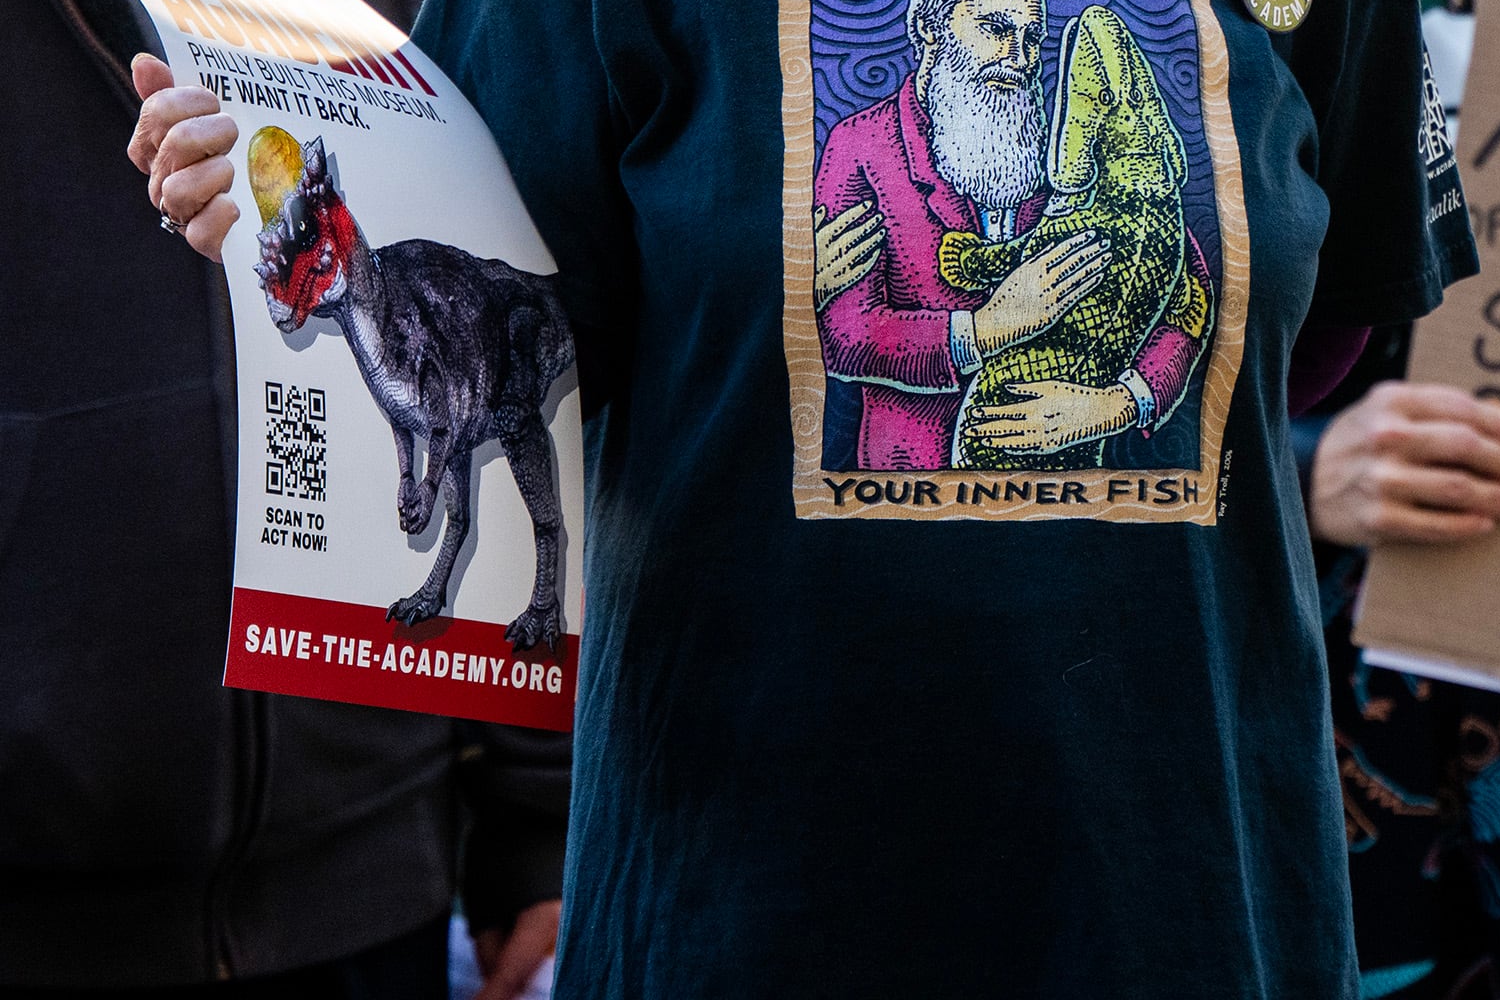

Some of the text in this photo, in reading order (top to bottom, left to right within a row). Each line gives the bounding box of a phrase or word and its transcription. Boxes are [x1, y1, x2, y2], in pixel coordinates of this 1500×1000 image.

[187, 41, 448, 125] PHILLY BUILT THIS MUSEUM.
[199, 72, 372, 131] WE WANT IT BACK.
[822, 476, 1200, 507] YOUR INNER FISH
[260, 527, 328, 552] ACT NOW!
[265, 506, 325, 531] SCAN TO
[244, 623, 563, 694] SAVE-THE-ACADEMY.ORG
